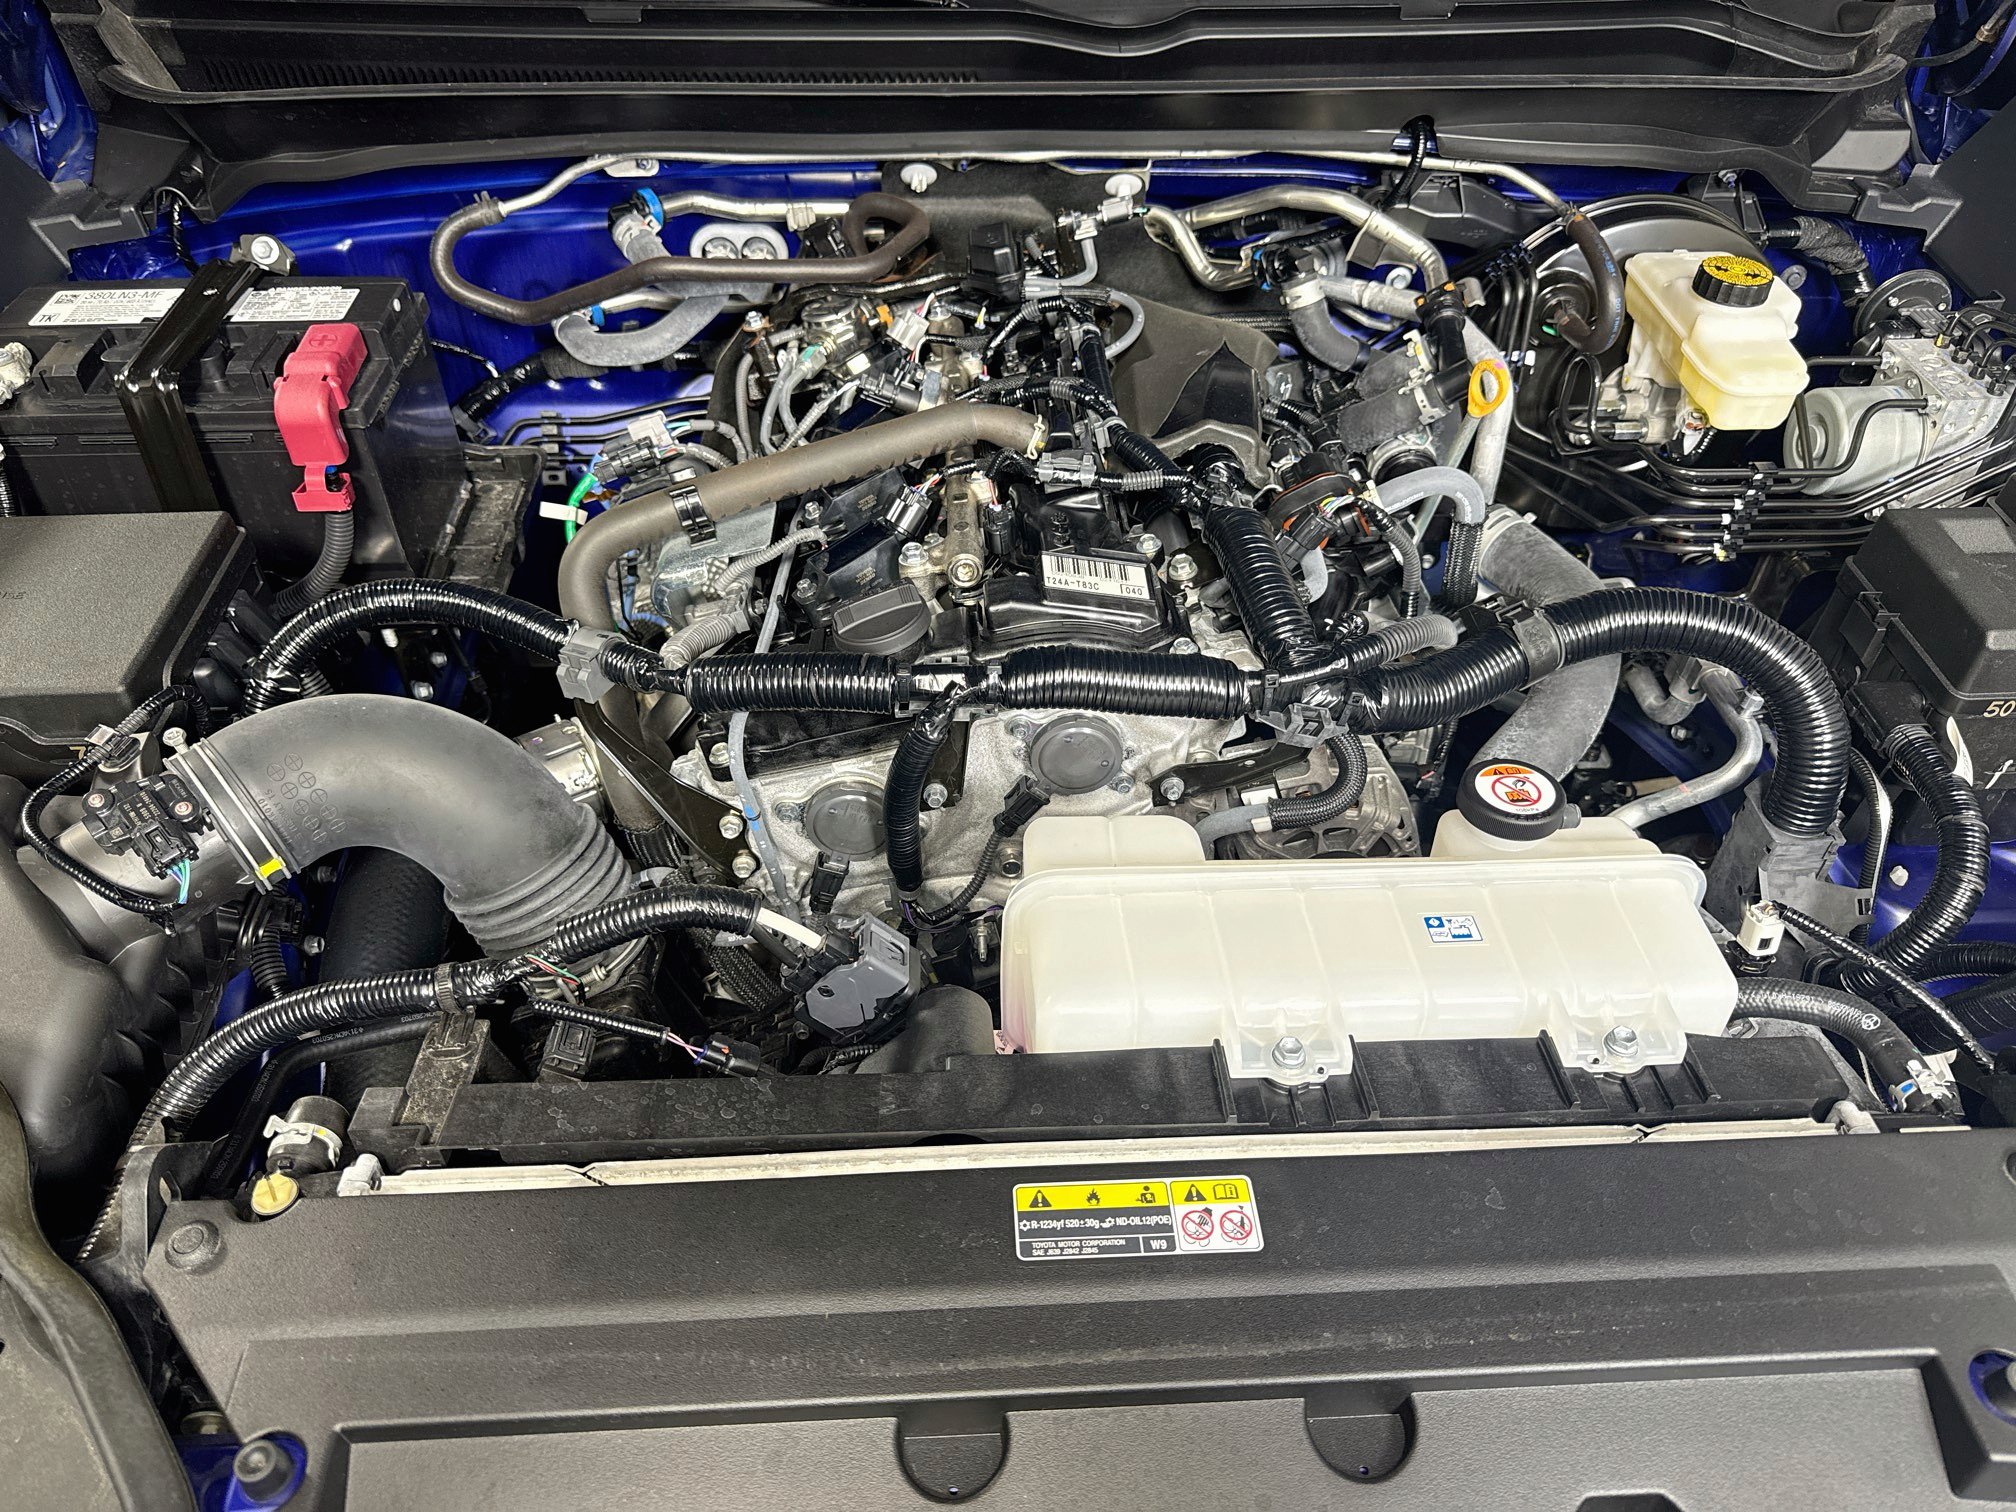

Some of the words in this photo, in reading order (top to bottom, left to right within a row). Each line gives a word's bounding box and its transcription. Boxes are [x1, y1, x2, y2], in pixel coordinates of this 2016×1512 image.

[84, 290, 164, 300] 380LN3-MF
[38, 314, 55, 323] TK
[1046, 576, 1100, 591] T24A-T83C
[1030, 1220, 1064, 1230] R-1234yf
[1066, 1219, 1100, 1229] 520±30g
[1150, 1240, 1168, 1250] W9
